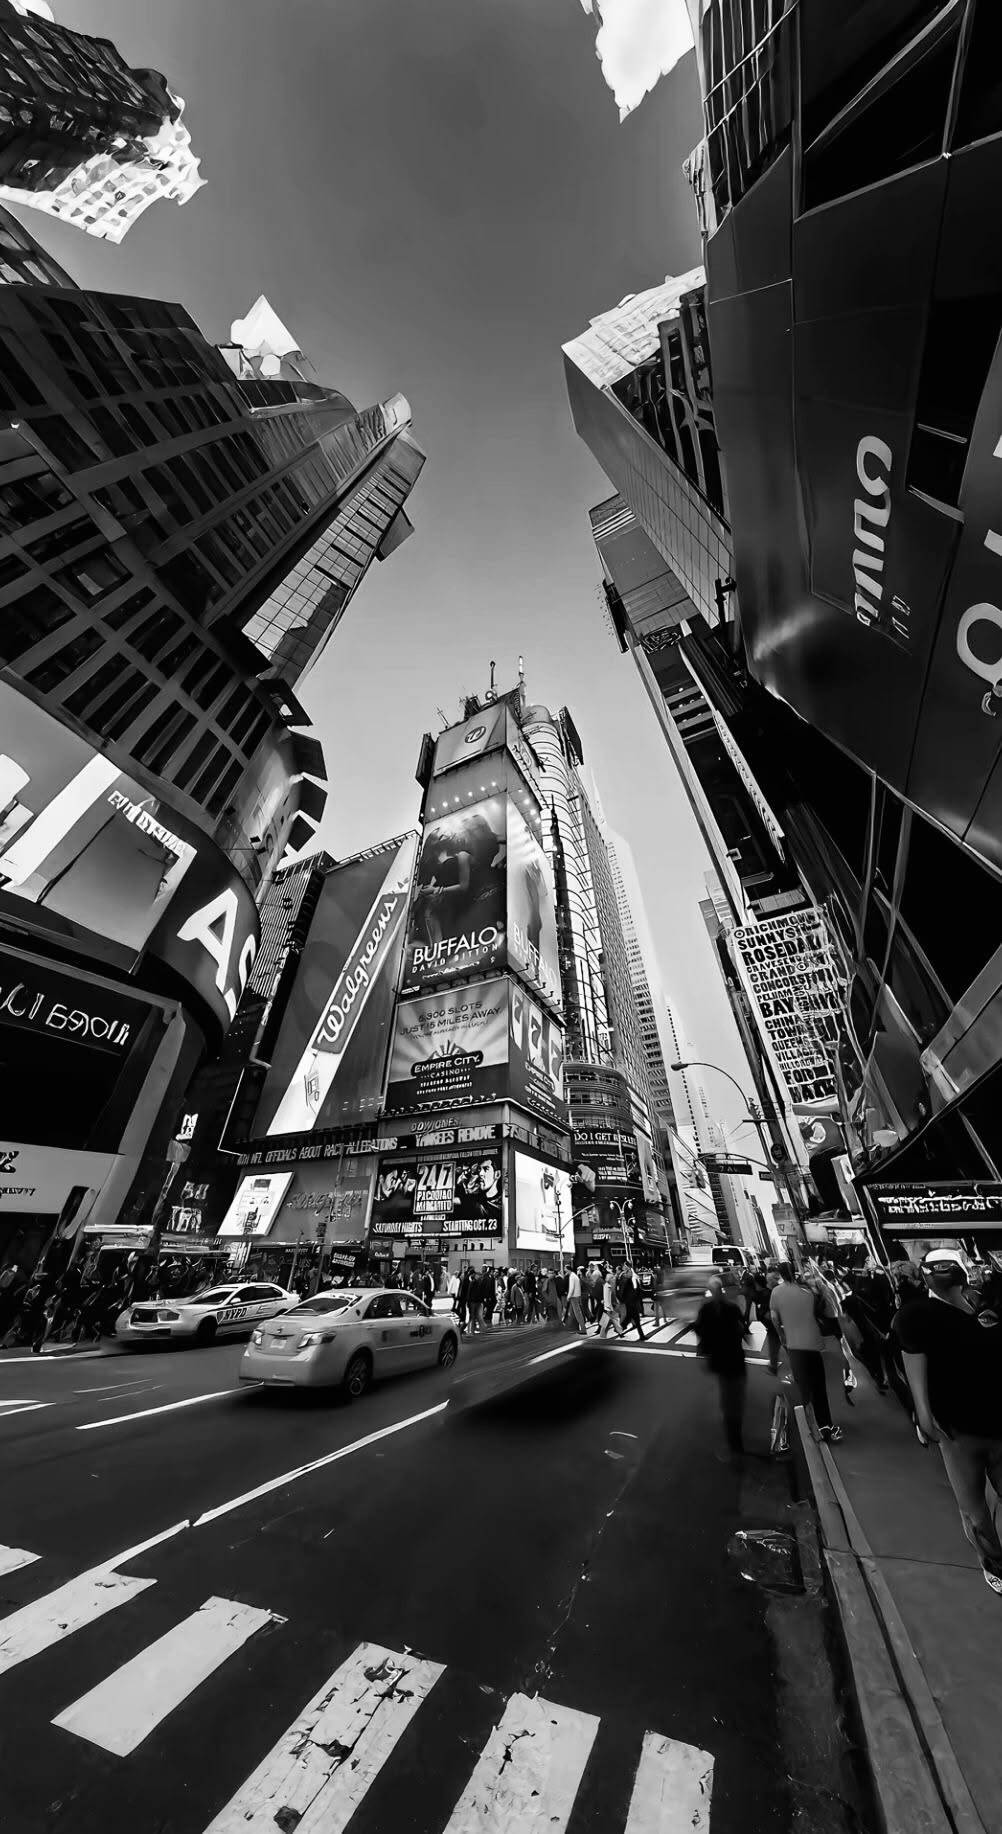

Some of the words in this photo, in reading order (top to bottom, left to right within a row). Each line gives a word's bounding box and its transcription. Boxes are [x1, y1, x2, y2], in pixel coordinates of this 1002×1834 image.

[412, 926, 498, 966] BUFFALO
[316, 895, 399, 1044] Walgreens
[411, 957, 446, 974] DAVID
[447, 1001, 483, 1015] SLOTS
[759, 997, 795, 1019] BAY
[400, 1023, 425, 1036] JUST
[437, 1014, 469, 1028] MILES
[470, 1007, 501, 1020] AWAY
[414, 1060, 453, 1073] EMPIRE
[429, 1069, 460, 1079] CASINO
[574, 1132, 587, 1141] DO
[590, 1133, 594, 1141] I
[595, 1132, 612, 1141] GET
[299, 1145, 323, 1160] ABOUT
[488, 1218, 498, 1230] 23
